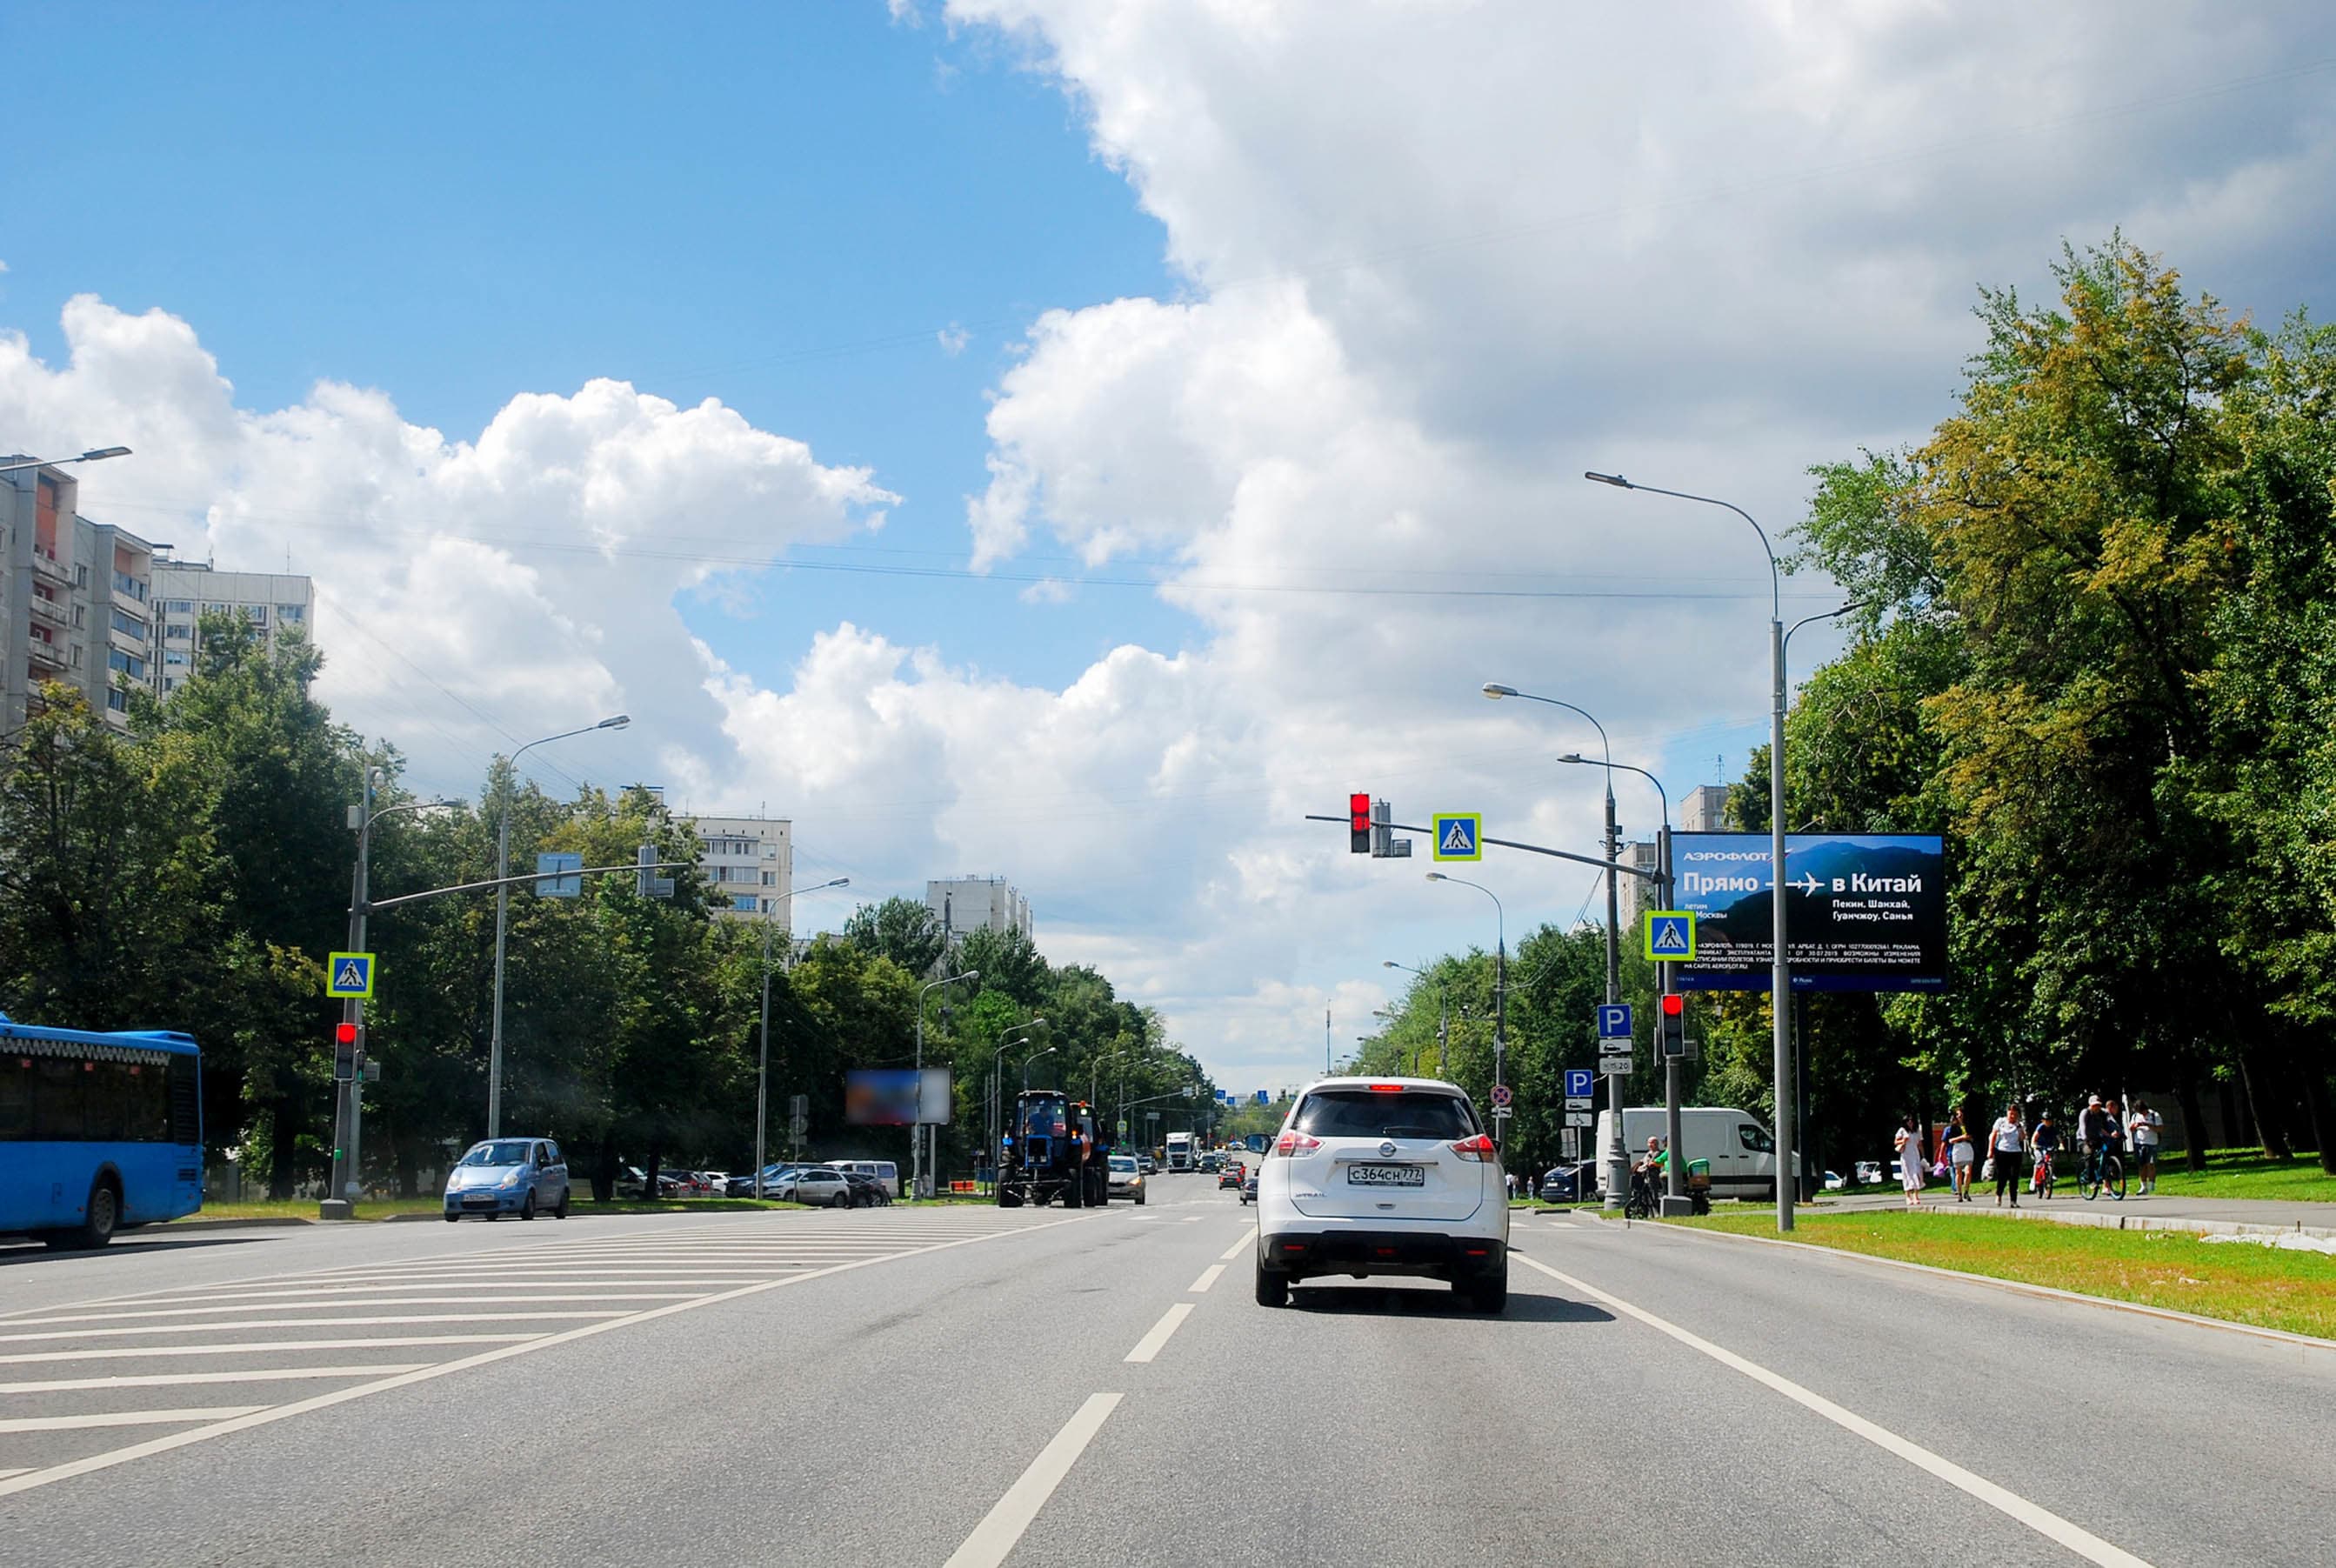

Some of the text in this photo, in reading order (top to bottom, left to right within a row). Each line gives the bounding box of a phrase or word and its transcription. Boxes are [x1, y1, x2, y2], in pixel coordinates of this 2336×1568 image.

[1683, 852, 1769, 862] АЭРОФЛОТ
[1684, 872, 1922, 896] Прямо в Китай
[1832, 899, 1911, 909] Пекин, Шанхай,
[1832, 911, 1913, 922] Гуанчжоу, Санья
[1606, 1009, 1625, 1033] P
[1572, 1073, 1587, 1093] P
[1402, 1169, 1420, 1178] 777
